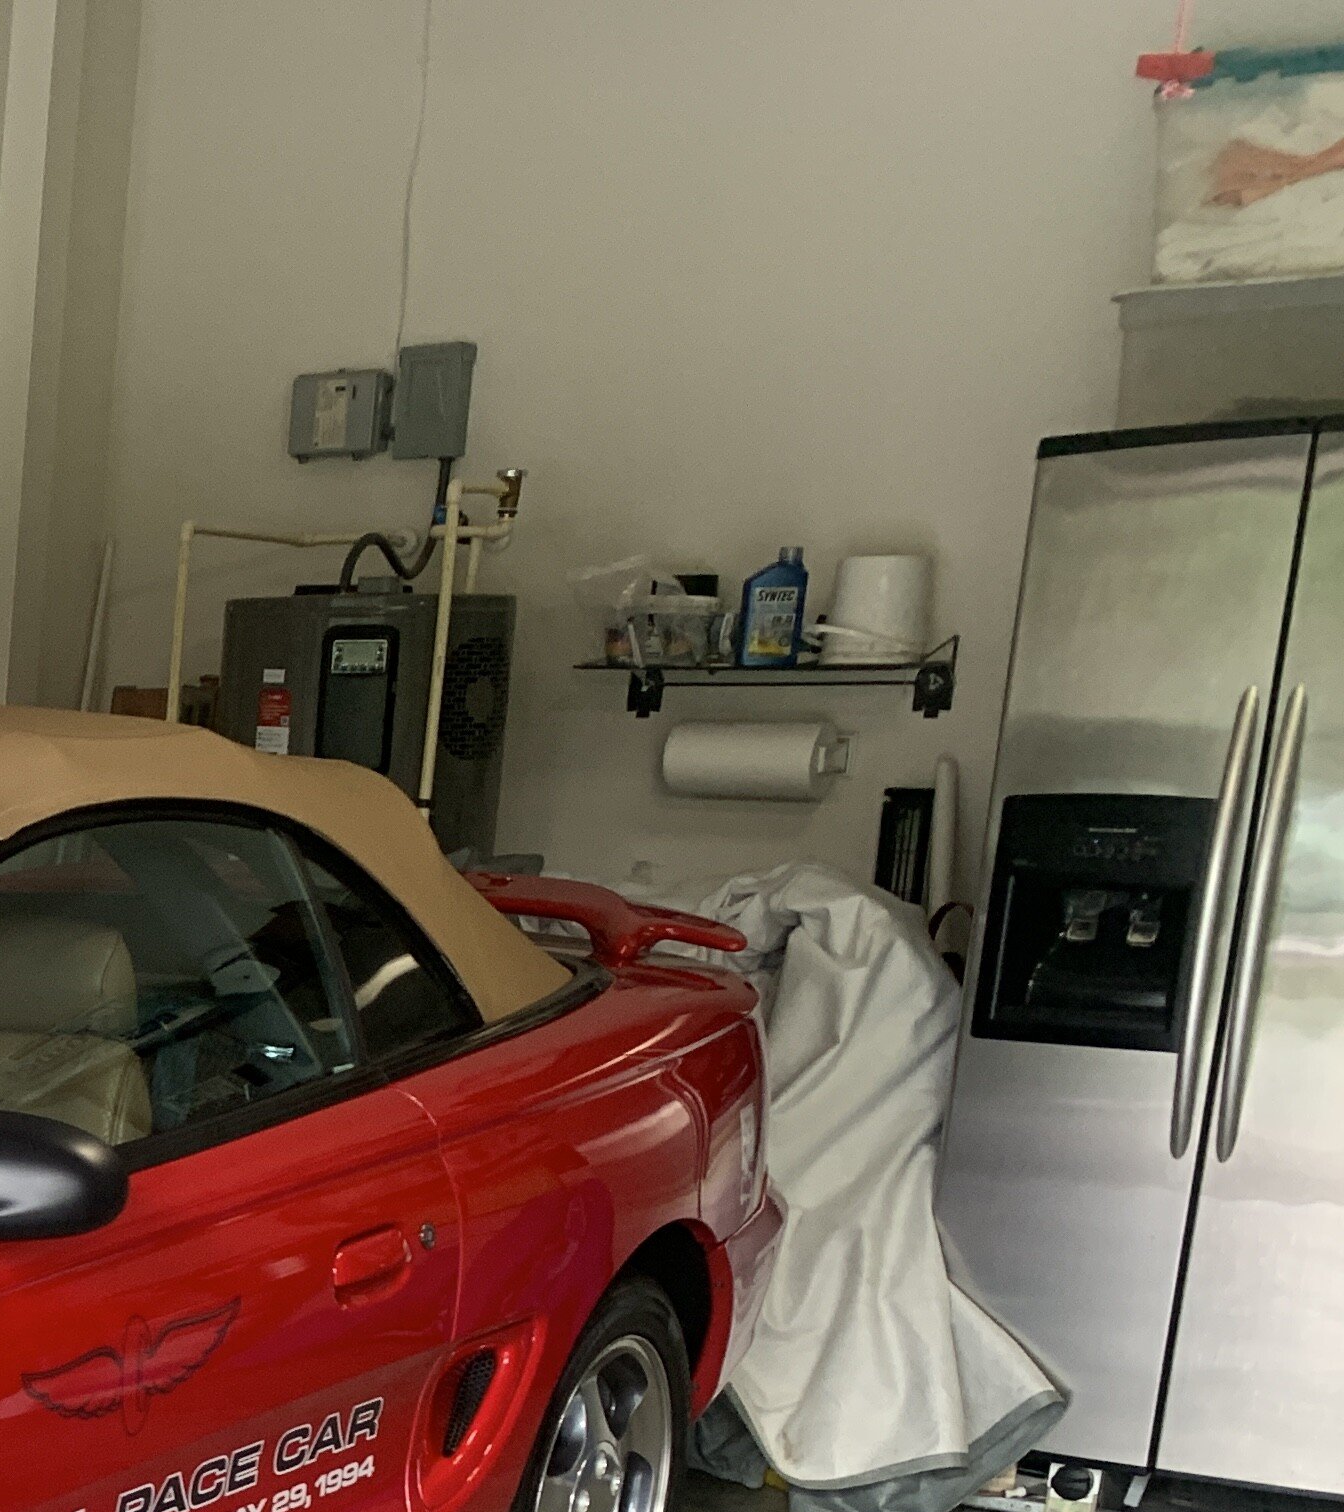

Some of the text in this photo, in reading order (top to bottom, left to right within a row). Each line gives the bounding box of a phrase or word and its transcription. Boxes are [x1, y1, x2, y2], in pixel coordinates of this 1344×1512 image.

[756, 589, 796, 602] SYNTEC
[273, 1397, 384, 1476] CAR
[315, 1455, 375, 1497] 1994
